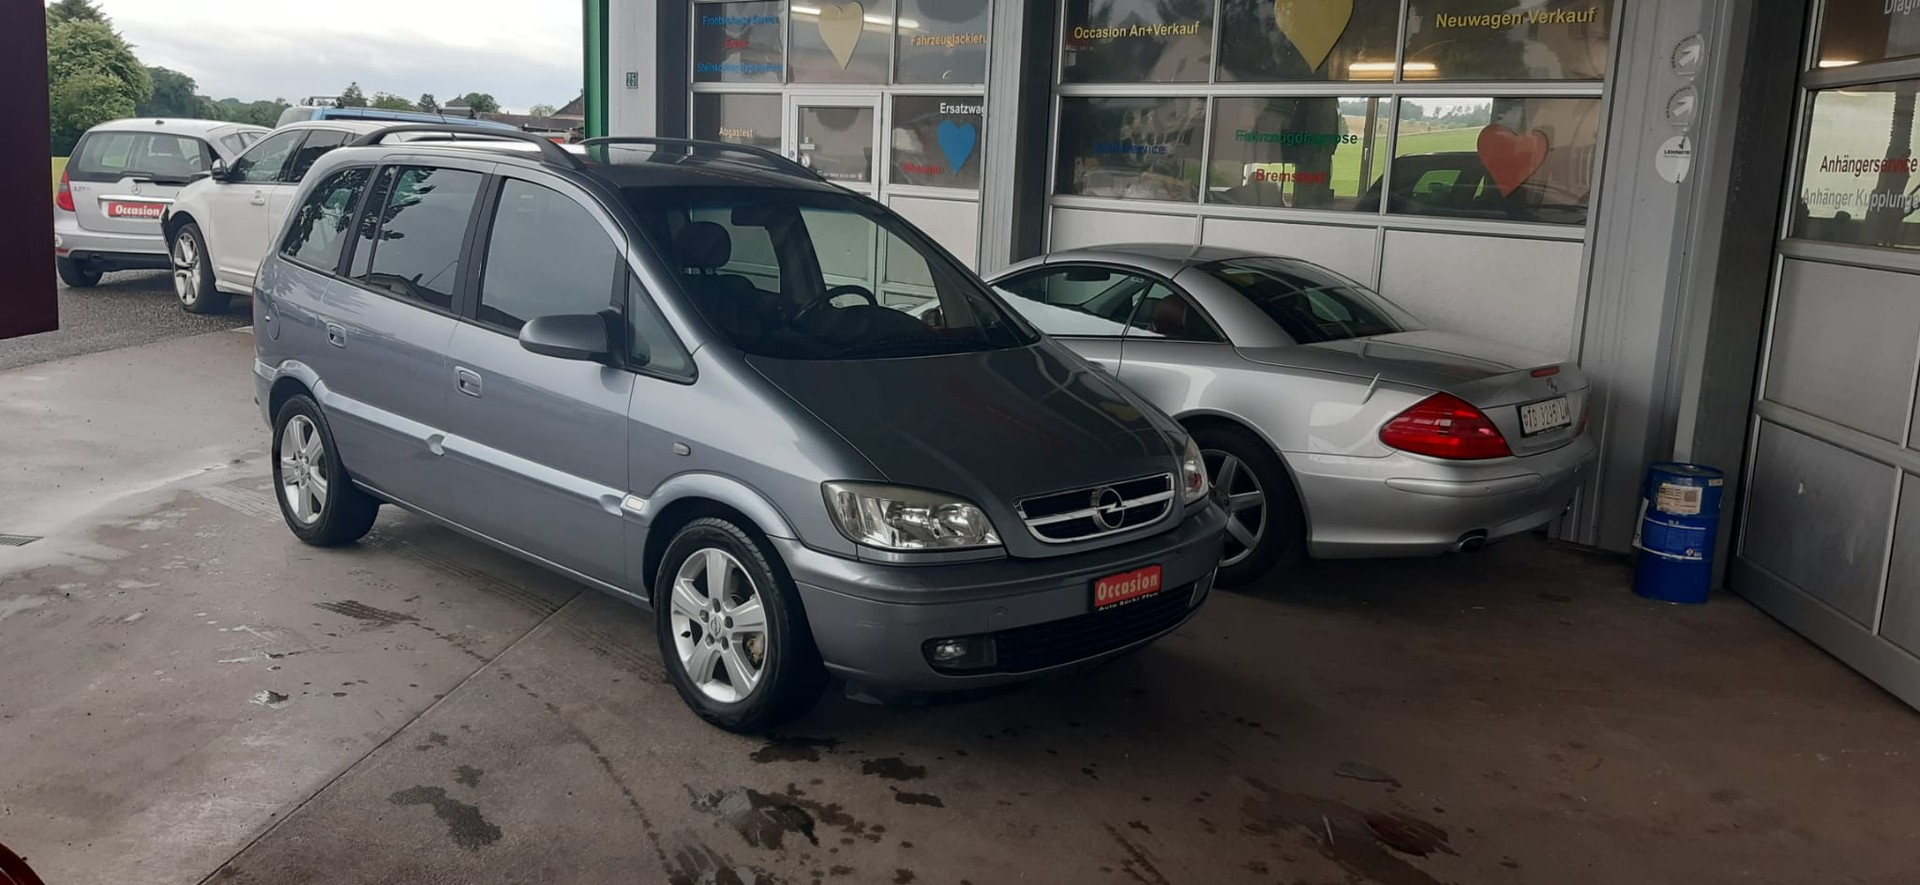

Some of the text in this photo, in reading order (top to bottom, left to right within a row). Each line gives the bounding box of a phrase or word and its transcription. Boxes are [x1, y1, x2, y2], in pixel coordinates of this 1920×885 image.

[1436, 8, 1597, 29] Neuwagen Verkauf
[1074, 21, 1200, 40] Occasion An+Verkauf
[719, 126, 753, 139] Abgastest
[1236, 129, 1358, 147] Fahrzeugdiagnose
[1820, 155, 1918, 178] Anhängerservice
[1801, 188, 1853, 210] Anhänger
[115, 204, 160, 216] Occasion
[1098, 573, 1158, 601] Occasion
